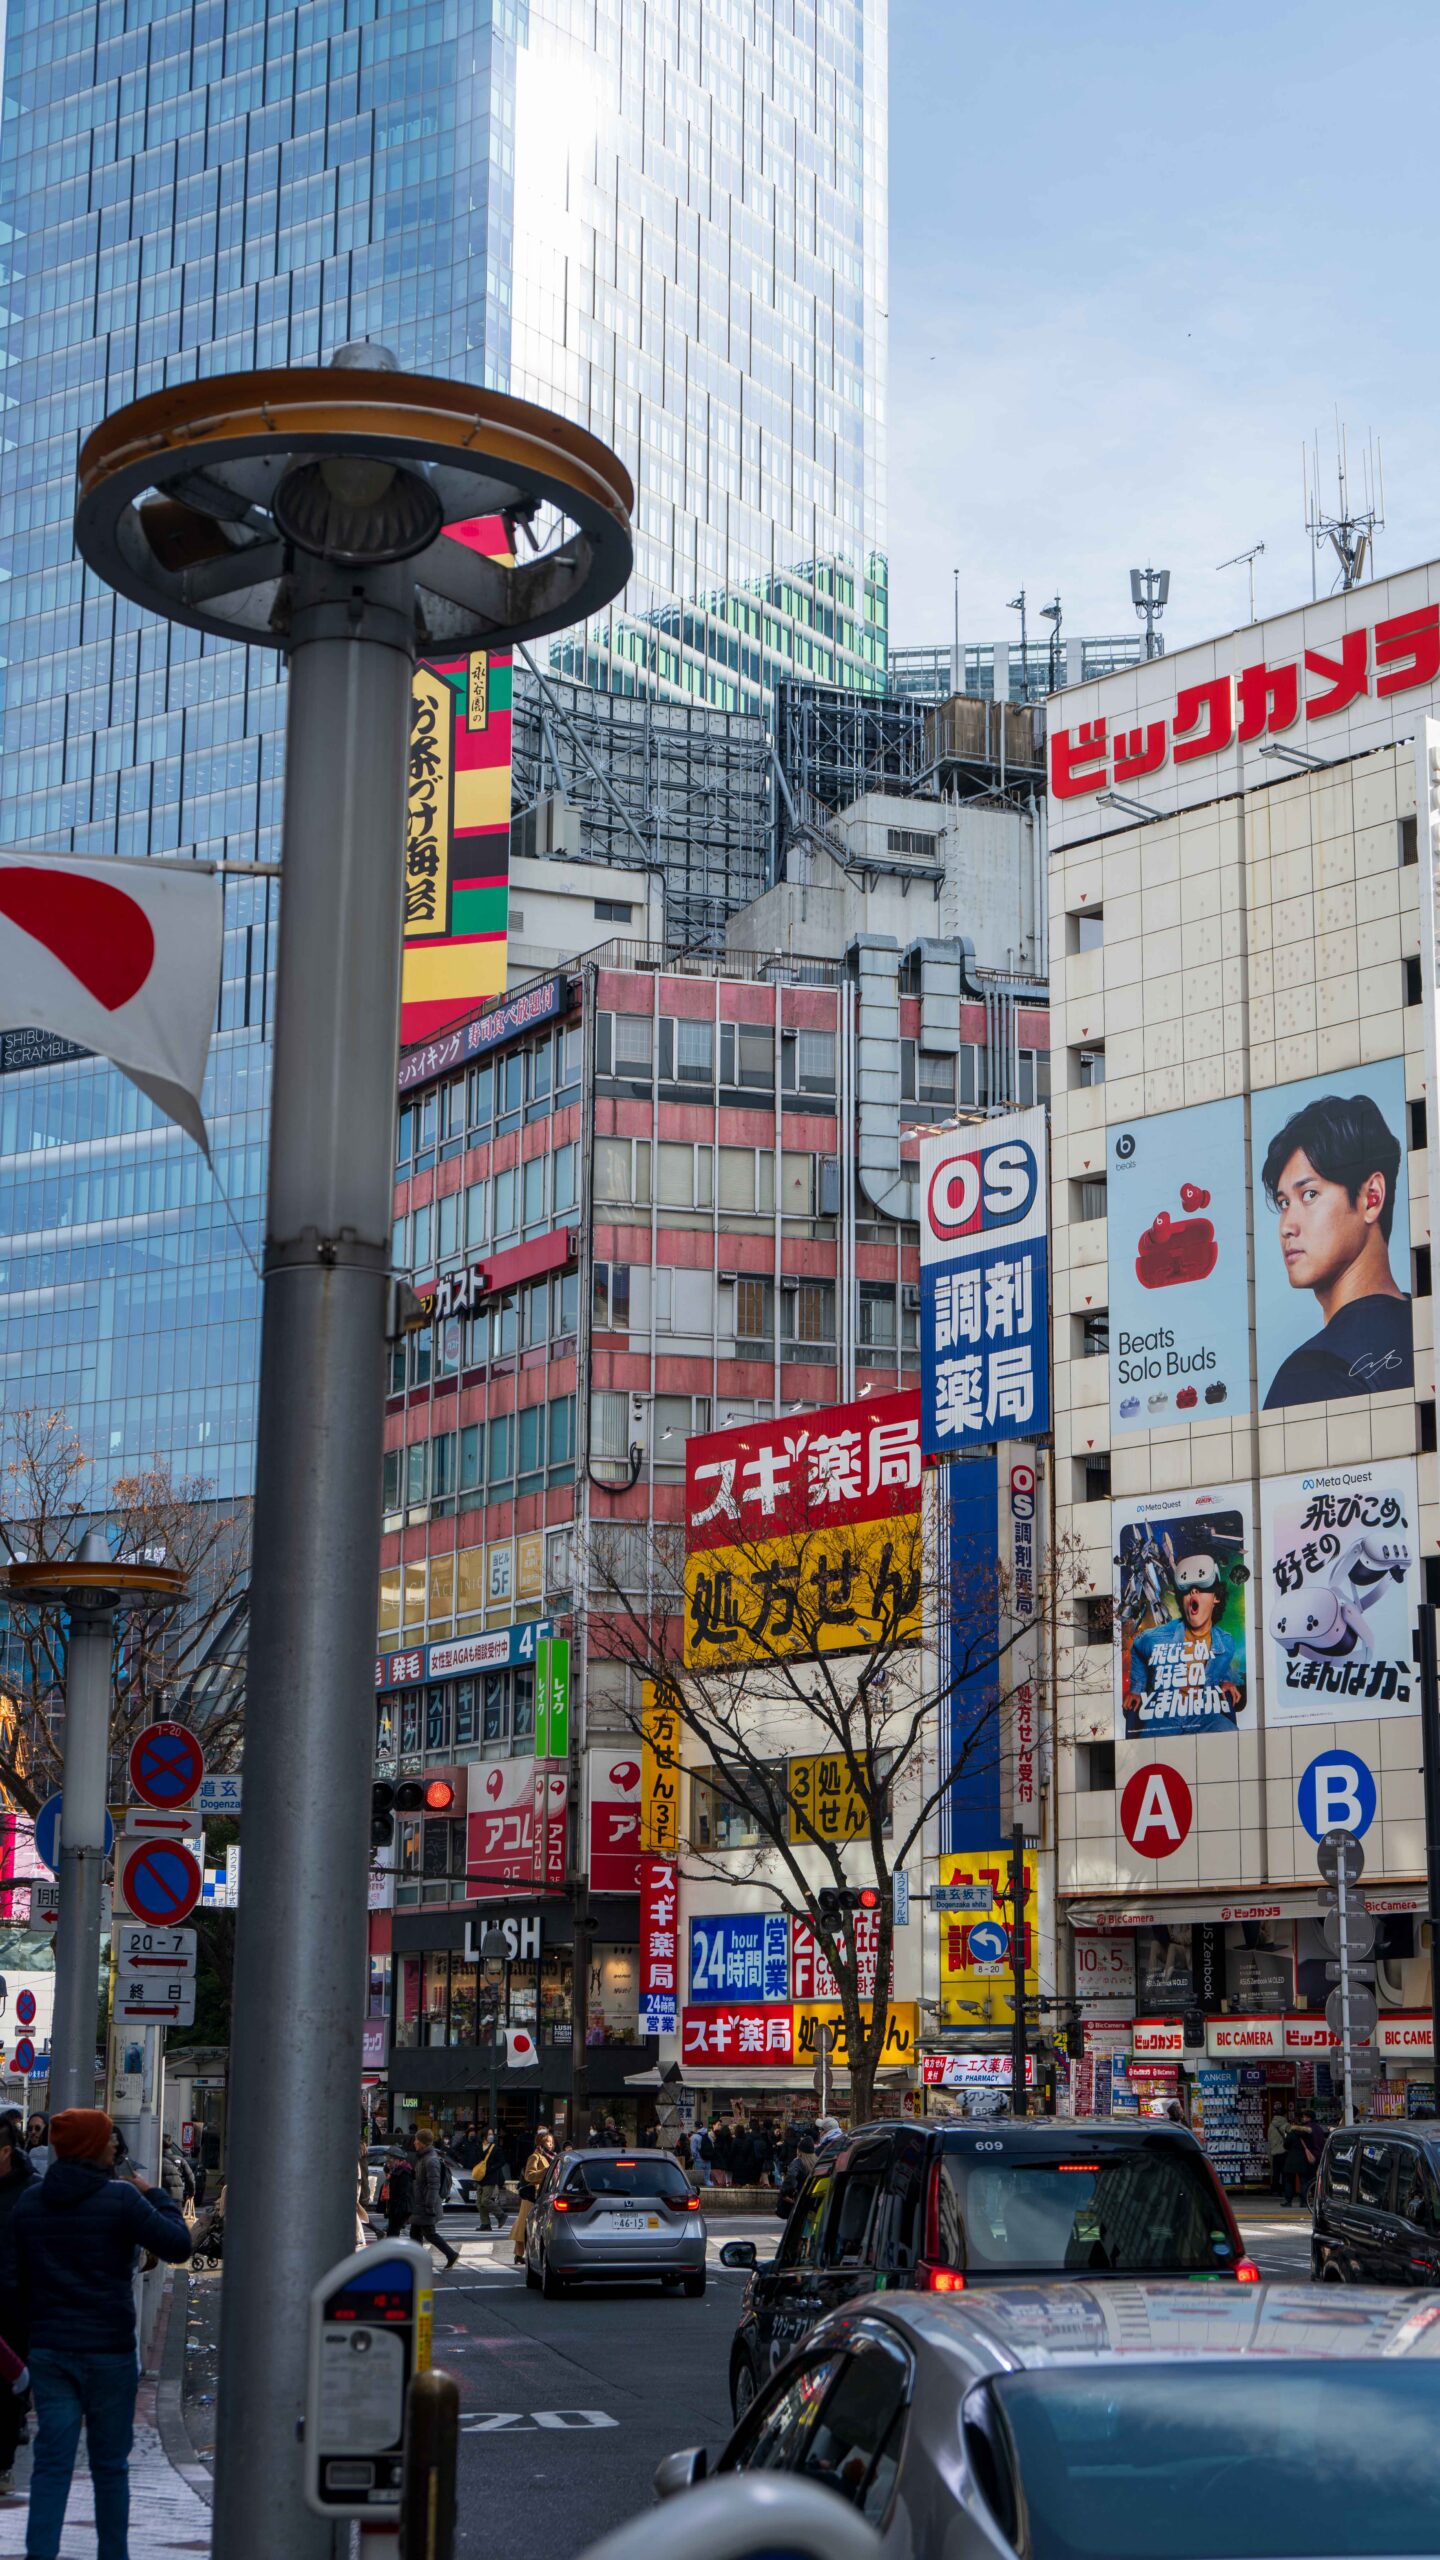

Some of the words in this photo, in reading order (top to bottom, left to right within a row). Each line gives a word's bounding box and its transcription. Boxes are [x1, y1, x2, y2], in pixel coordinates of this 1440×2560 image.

[471, 661, 486, 723] 永谷園の
[1051, 602, 1440, 800] ビックカメラ
[468, 982, 554, 1050] 寿司食べ放題付
[4, 1040, 75, 1066] SCRAMBLE
[1115, 1160, 1137, 1172] beats
[929, 1143, 1030, 1233] OS
[435, 1264, 486, 1318] ガスト
[934, 1255, 1034, 1353] 調剤
[1118, 1327, 1175, 1357] Beats
[1118, 1358, 1163, 1384] Solo
[1166, 1349, 1217, 1376] Buds
[934, 1345, 1035, 1439] 薬局
[691, 1418, 922, 1527] スギ薬局
[1315, 1475, 1341, 1489] Meta
[1342, 1471, 1372, 1487] Quest
[1145, 1503, 1162, 1511] Meta
[1162, 1500, 1182, 1510] Quest
[1300, 1493, 1409, 1531] 飛びこめ、
[1272, 1533, 1341, 1594] 好きの
[491, 1569, 510, 1596] 5F
[690, 1541, 922, 1648] 処方せん
[392, 1654, 420, 1682] 発毛
[431, 1639, 508, 1671] 女性型AGAも相談受付中
[1154, 1662, 1207, 1690] 好きの
[537, 1678, 545, 1717] レイク
[553, 1678, 565, 1715] レイク
[156, 1725, 182, 1737] 7-20
[653, 1681, 676, 1799] 処方せん
[1017, 1685, 1034, 1802] 処方せん受付
[200, 1781, 238, 1798] 道玄
[200, 1799, 240, 1810] Dogenza
[1314, 1764, 1363, 1835] B
[818, 1798, 869, 1835] せん
[1132, 1774, 1181, 1842] A
[608, 1814, 640, 1842] ア
[549, 1823, 564, 1871] アコム
[229, 1848, 237, 1905] スクランブル式
[896, 1873, 906, 1923] スクランブル式
[935, 1888, 988, 1900] 道玄坂下
[936, 1901, 970, 1910] Dogenzaka
[1365, 1900, 1418, 1912] BicCamera
[649, 1865, 674, 1990] スギ薬局
[1108, 1914, 1155, 1924] BicCamera
[1234, 1907, 1281, 1919] ビックカメラ
[130, 1934, 183, 1952] 20-7
[764, 1917, 788, 1998] 営業
[692, 1930, 726, 1990] 24
[731, 1930, 759, 1949] hour
[726, 1950, 763, 1989] 時間
[1077, 1948, 1098, 1972] 10
[1110, 1948, 1123, 1972] 5
[1203, 1940, 1215, 2000] Zenbook
[646, 1994, 661, 2013] 24
[646, 2015, 675, 2033] 営業
[684, 2016, 792, 2053] スギ薬局
[1216, 2032, 1232, 2046] BIC
[1233, 2031, 1274, 2046] CAMERA
[1286, 2030, 1370, 2047] ビックカ
[1385, 2031, 1401, 2045] BIC
[1134, 2034, 1182, 2050] ビックカメラ
[946, 2057, 1013, 2073] オーエス薬局
[1204, 2073, 1232, 2081] ANKER
[402, 2097, 418, 2108] LUSH
[975, 2141, 1004, 2151] 609
